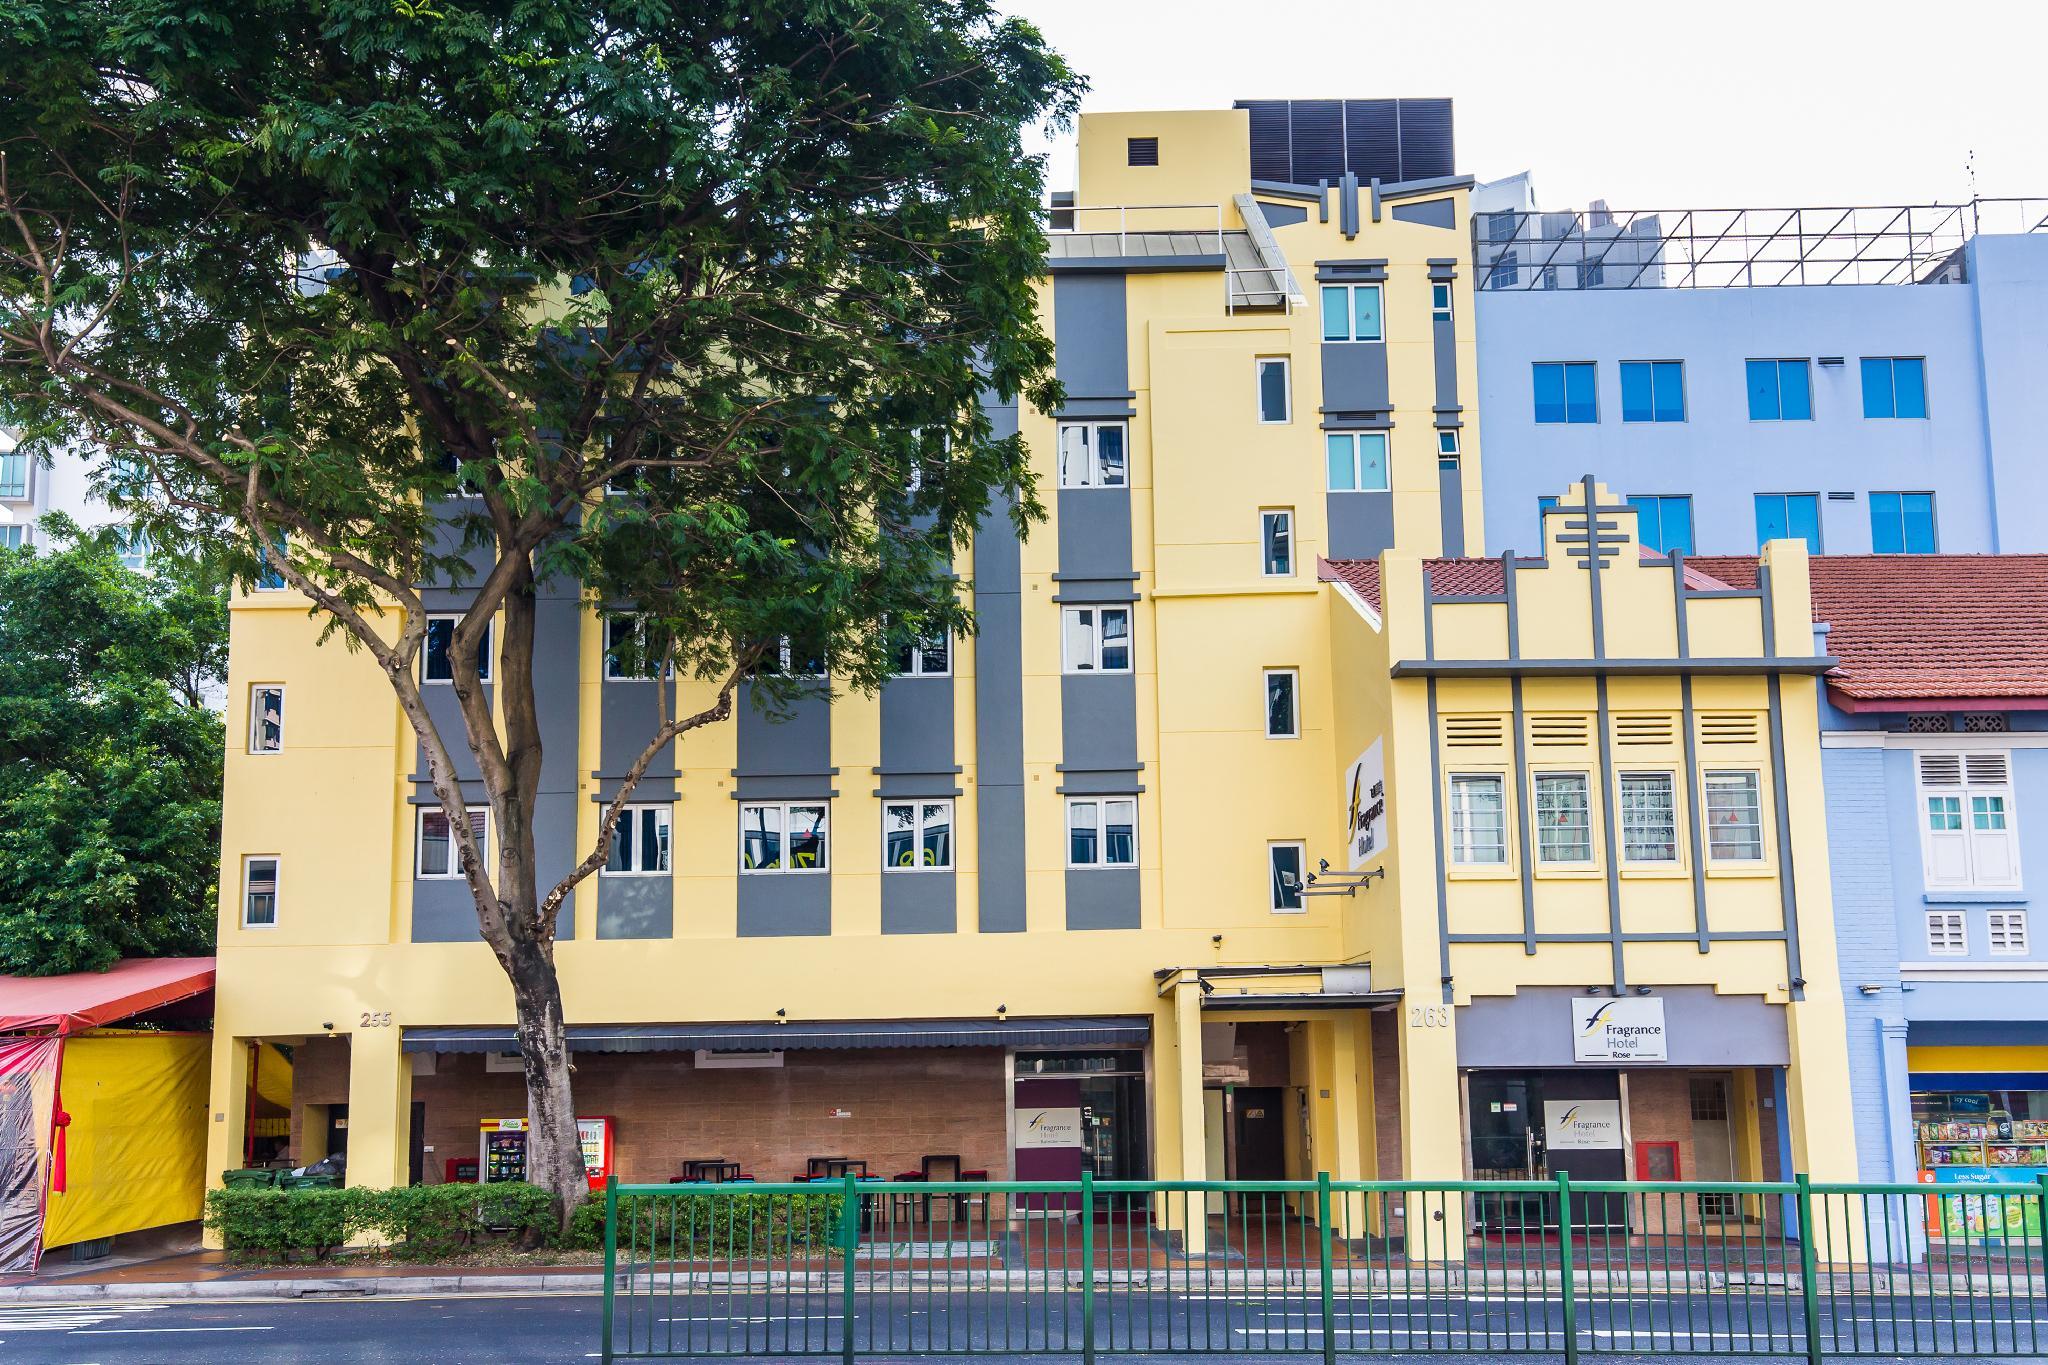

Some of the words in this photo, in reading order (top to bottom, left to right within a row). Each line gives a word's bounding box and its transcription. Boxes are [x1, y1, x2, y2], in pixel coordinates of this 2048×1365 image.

[360, 1011, 391, 1028] 255
[1410, 1005, 1450, 1027] 263
[1606, 1024, 1661, 1037] Fragrance
[1607, 1037, 1638, 1049] Hotel
[1612, 1051, 1631, 1059] Rose
[1573, 1120, 1610, 1130] Fragrance
[1971, 1173, 1991, 1181] Sugar
